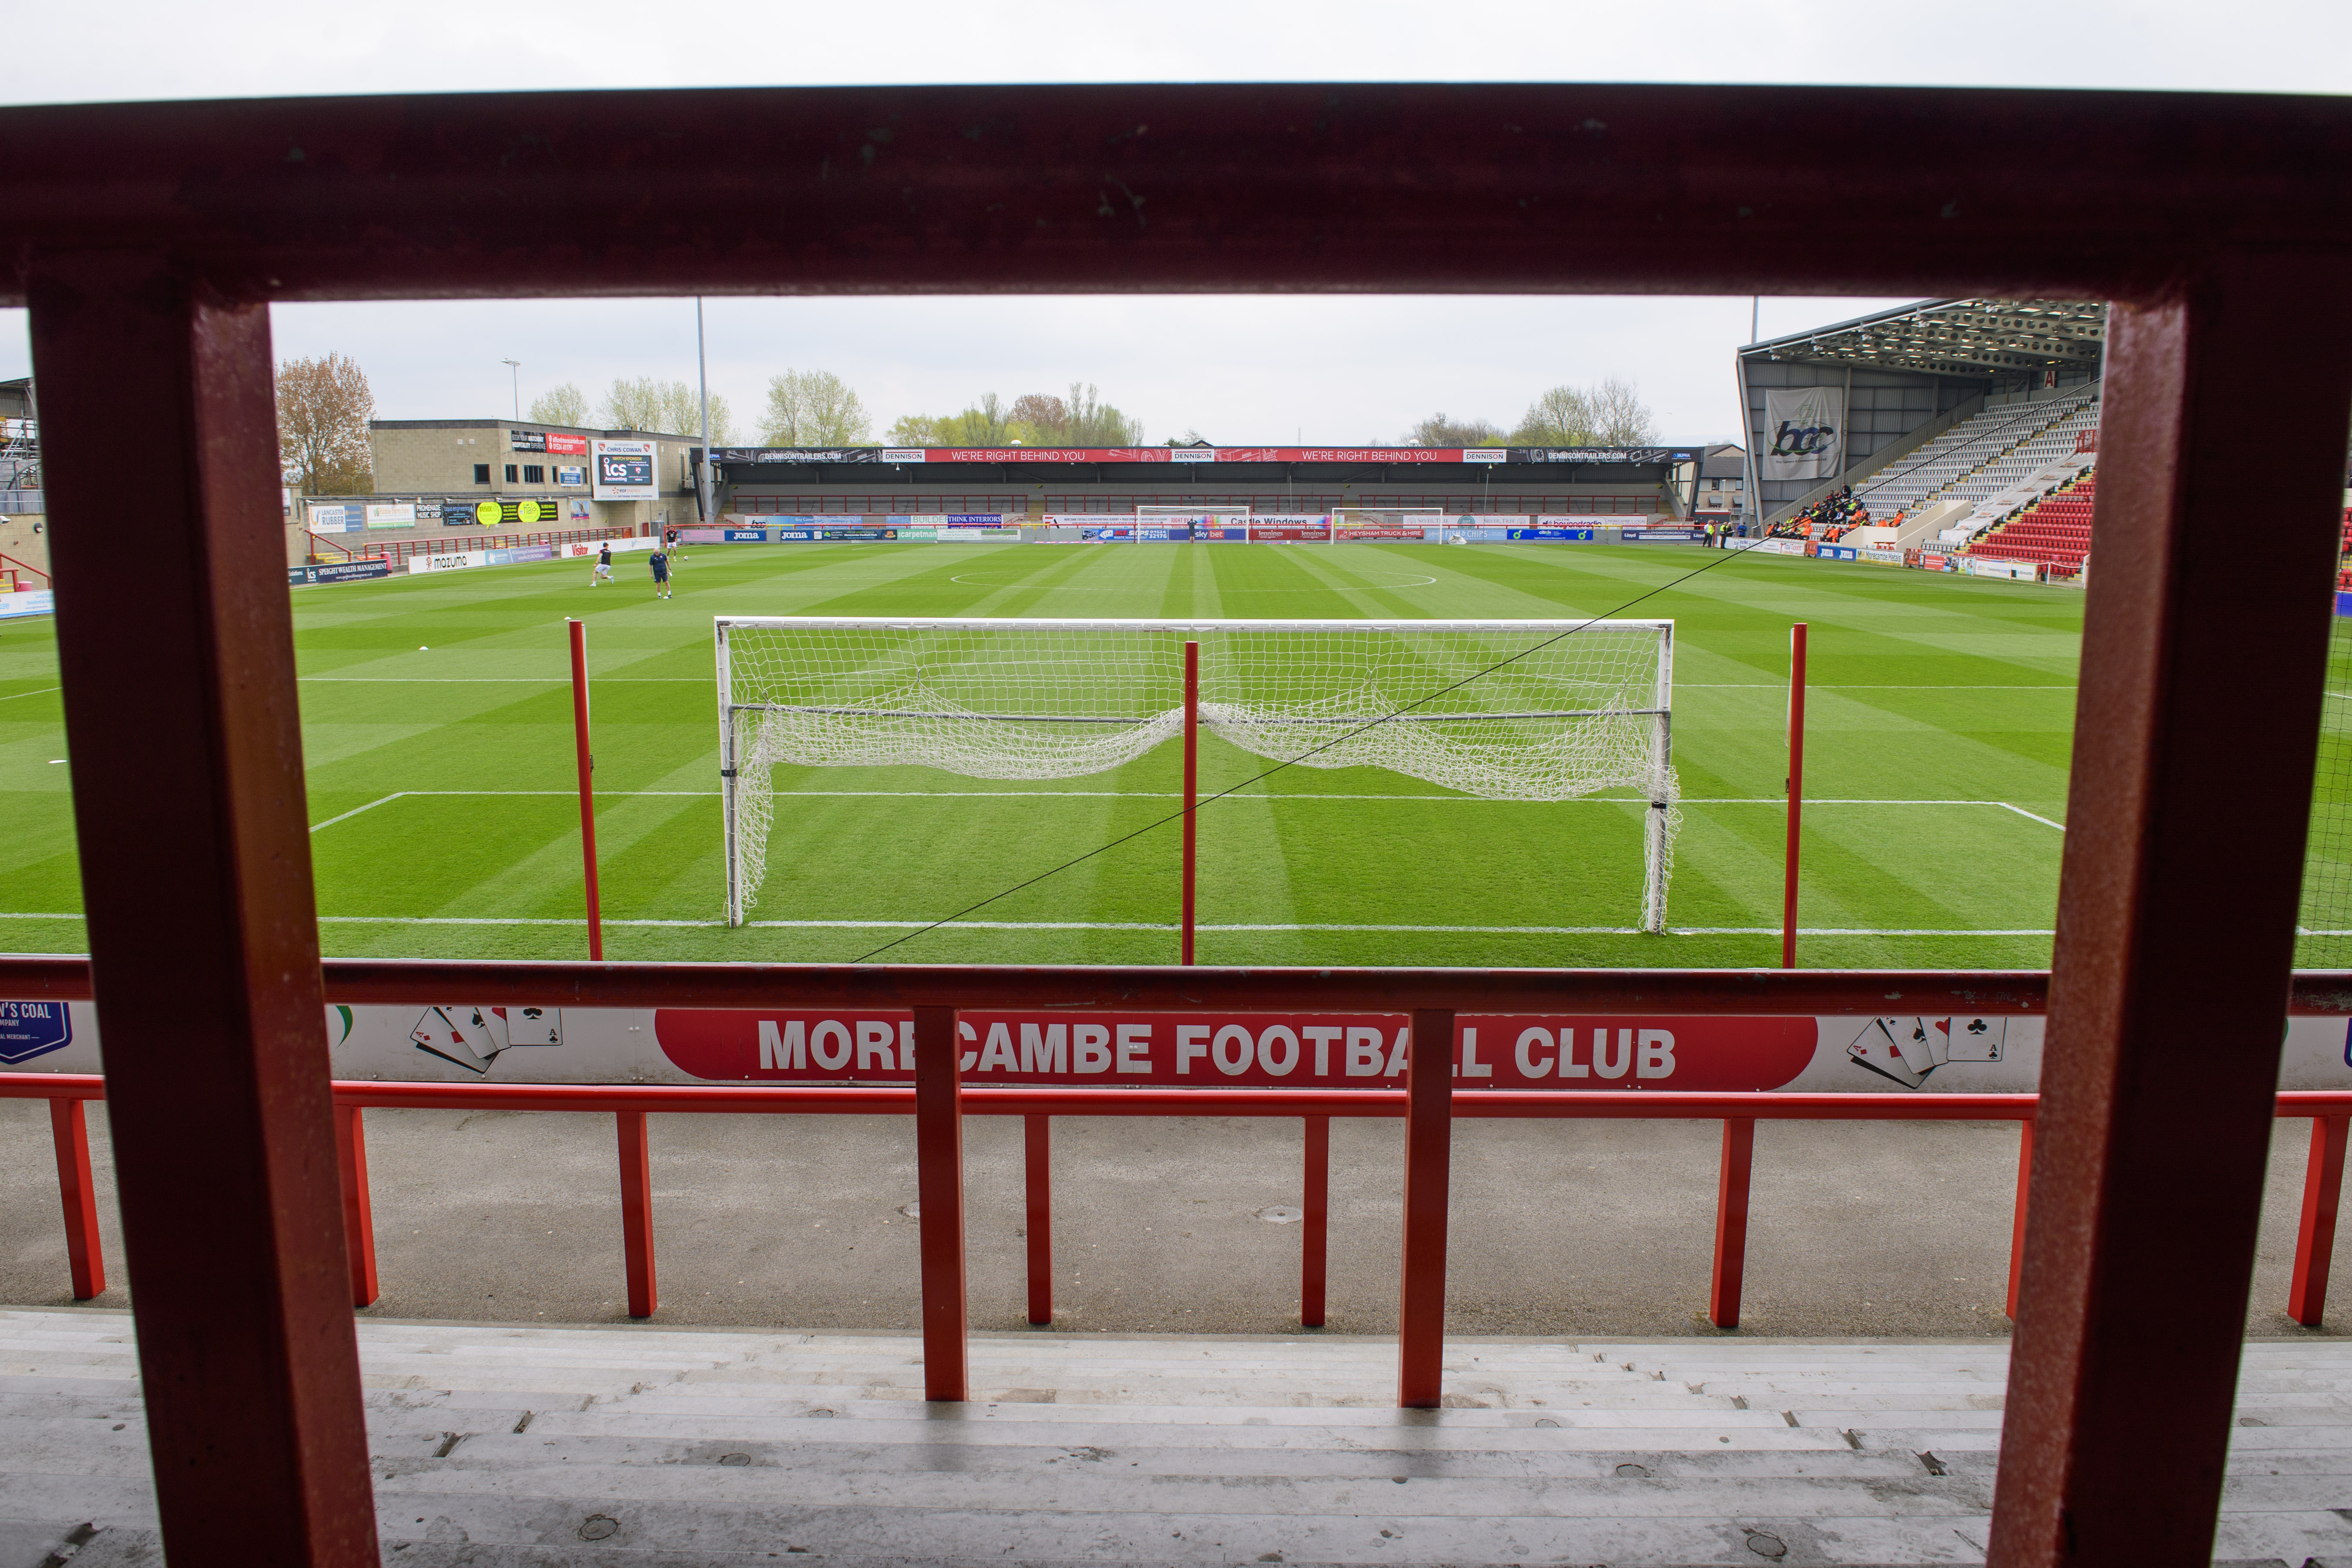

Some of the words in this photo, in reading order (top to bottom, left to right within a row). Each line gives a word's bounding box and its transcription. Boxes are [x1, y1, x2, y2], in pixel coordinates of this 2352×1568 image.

[2044, 371, 2053, 388] A
[1770, 421, 1834, 456] bcc
[951, 451, 983, 460] WE'RE
[987, 451, 1017, 460] RIGHT
[1021, 451, 1059, 460] BEHIND
[1062, 451, 1085, 460] YOU
[1302, 451, 1334, 460] WE'RE
[1337, 451, 1369, 460] RIGHT
[1371, 451, 1411, 460] BEHIND
[1415, 451, 1437, 460] YOU
[322, 516, 345, 525] RUBBER
[901, 531, 936, 539] carpetman
[572, 544, 588, 556] Visitor
[1866, 551, 1887, 561] Morecambe
[1889, 553, 1901, 562] Metals
[434, 555, 467, 569] mazuma
[319, 568, 338, 576] SPEIGHT
[338, 565, 356, 574] WEALTH
[356, 562, 387, 572] MANAGEMENT
[21, 1004, 52, 1018] COAL
[1176, 1024, 1492, 1077] FOOTBAL
[1515, 1027, 1676, 1079] CLUB
